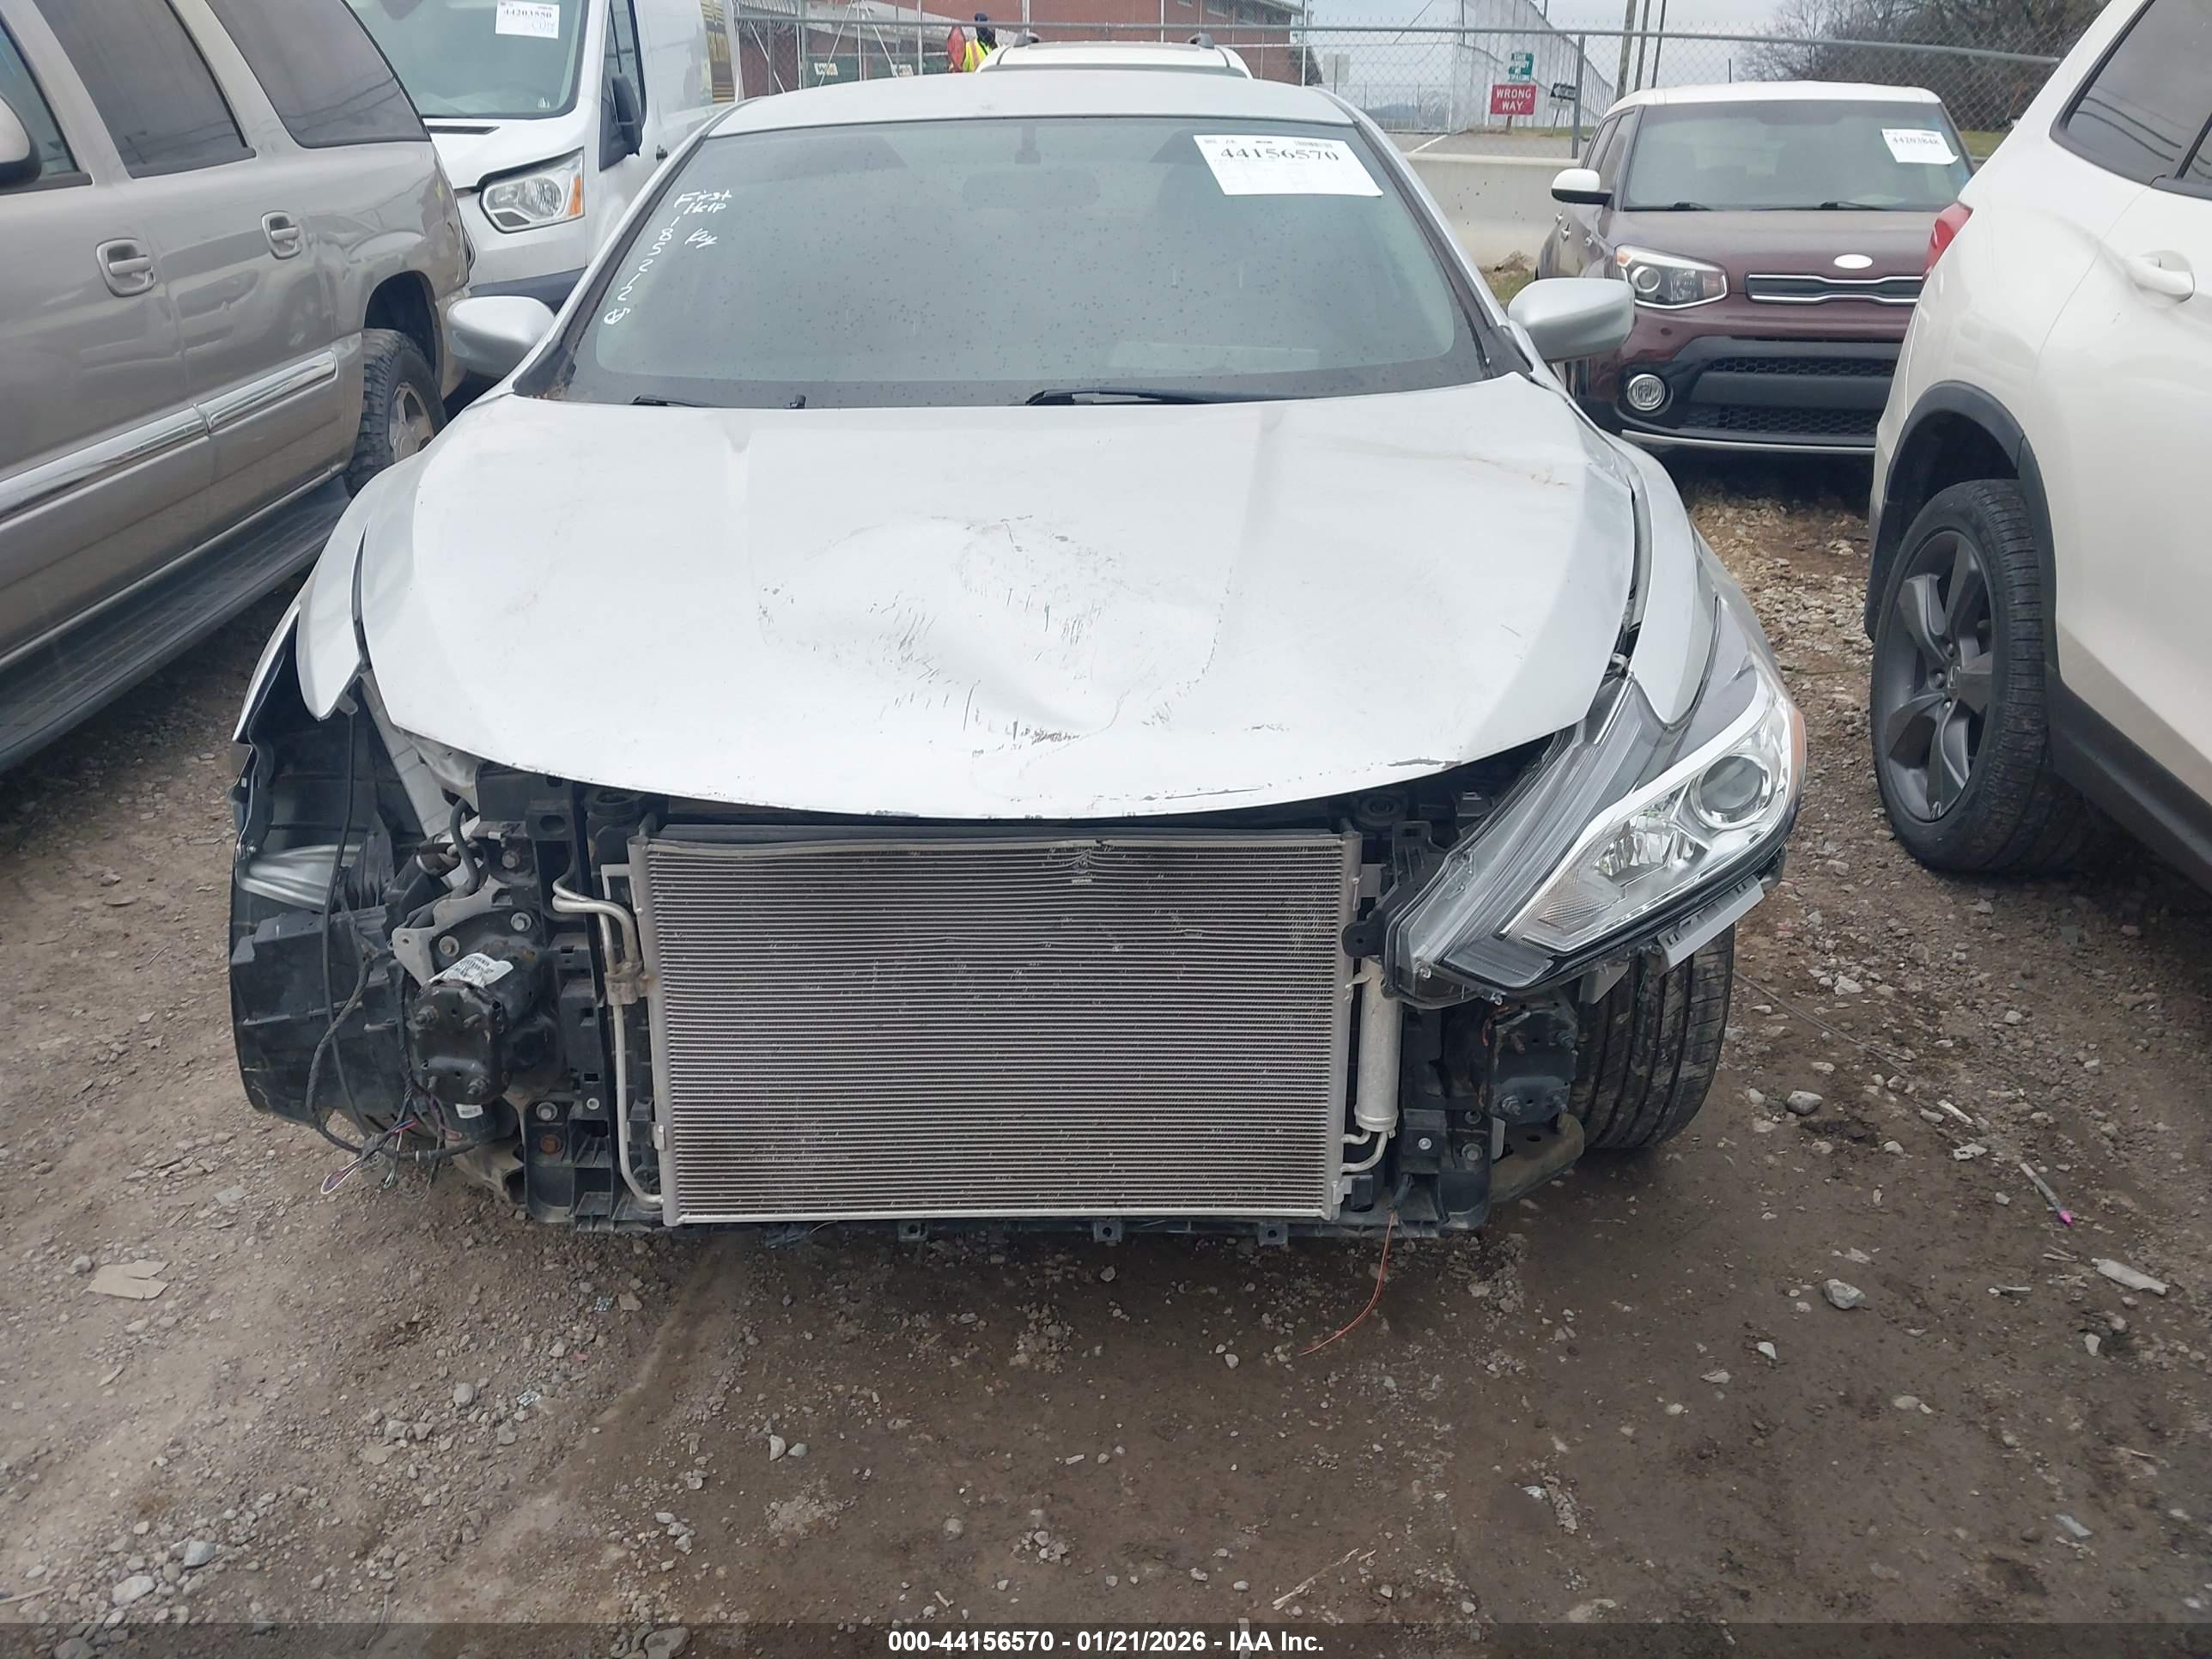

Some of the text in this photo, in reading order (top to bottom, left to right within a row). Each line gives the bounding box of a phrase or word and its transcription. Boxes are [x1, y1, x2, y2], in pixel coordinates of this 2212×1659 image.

[1496, 88, 1532, 99] WRONG
[1502, 100, 1523, 111] WAY
[1221, 148, 1340, 161] 44156570
[673, 189, 732, 208] First
